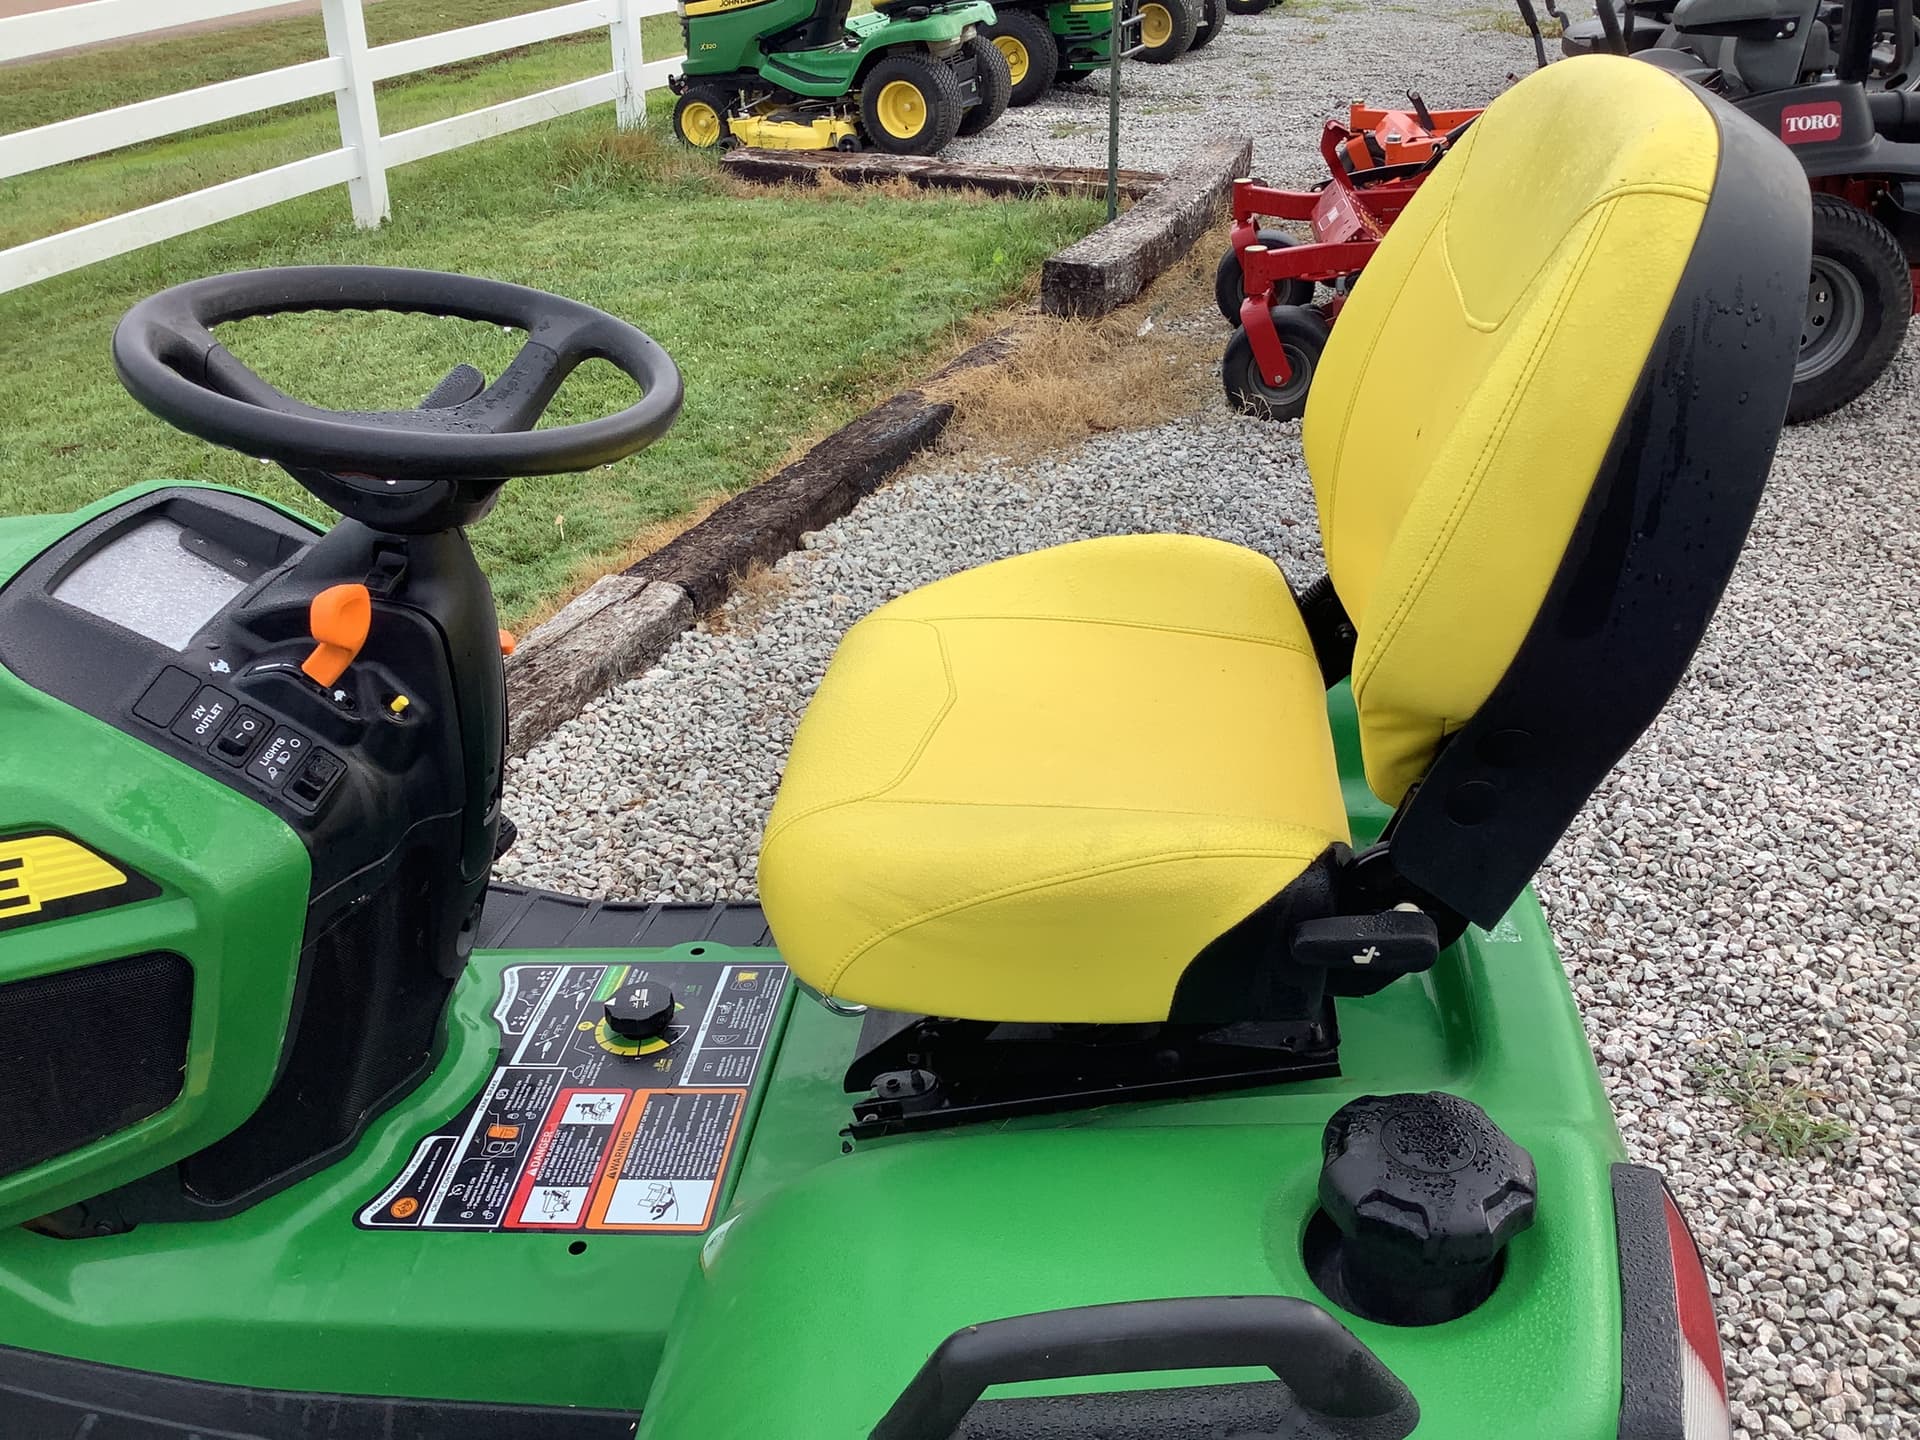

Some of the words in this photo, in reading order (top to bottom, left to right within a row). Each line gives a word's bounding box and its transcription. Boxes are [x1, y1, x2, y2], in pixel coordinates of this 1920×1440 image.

[1786, 113, 1838, 132] TORO
[191, 704, 207, 722] 12V
[195, 703, 224, 735] OUTLET
[259, 737, 286, 766] LIGHTS
[531, 1131, 554, 1168] DANGER
[612, 1131, 632, 1172] WARNING
